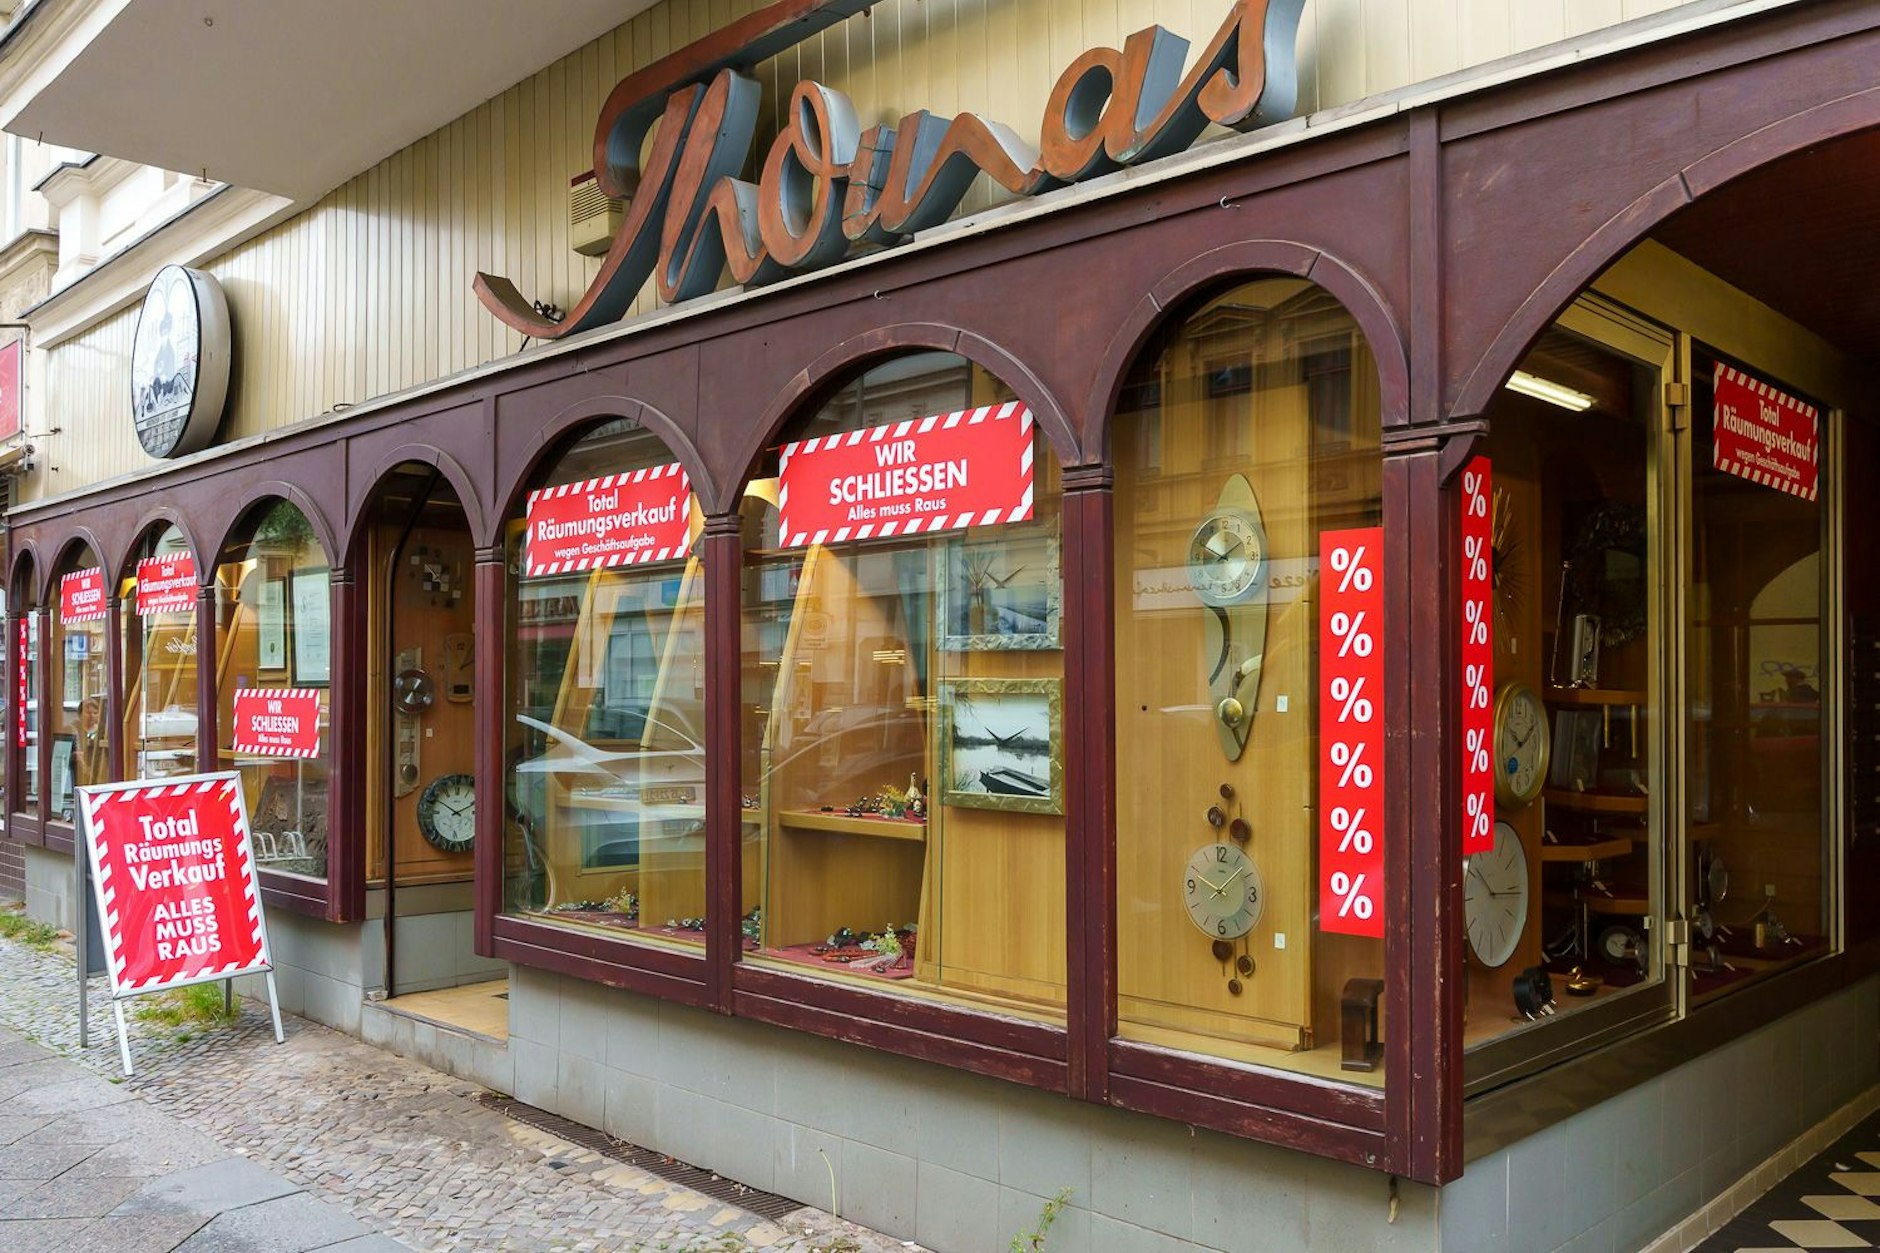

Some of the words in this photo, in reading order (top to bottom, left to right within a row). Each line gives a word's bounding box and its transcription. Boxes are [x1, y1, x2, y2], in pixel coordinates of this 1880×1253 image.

[1759, 400, 1780, 427] Total
[1722, 404, 1811, 462] Räumungsverkauf
[875, 440, 916, 467] WIR
[1735, 448, 1755, 464] wegen
[829, 459, 968, 505] SCHLIESSEN
[1464, 471, 1486, 517] %
[587, 488, 619, 513] Total
[848, 505, 877, 522] Alles
[879, 503, 912, 517] muss
[915, 497, 947, 512] Raus
[538, 496, 676, 541] Räumungsverkauf
[554, 546, 581, 559] wegen
[581, 533, 656, 555] Geschäftsaufgabe
[1464, 534, 1487, 581] %
[1330, 546, 1374, 593] %
[1330, 611, 1374, 658] %
[1465, 599, 1488, 645] %
[1330, 677, 1374, 723] %
[1465, 664, 1488, 709] %
[267, 700, 283, 714] WIR
[251, 715, 299, 734] SCHLIESSEN
[1330, 742, 1374, 788] %
[1466, 728, 1489, 774] %
[138, 809, 199, 841] Total
[1466, 792, 1489, 838] %
[1330, 807, 1374, 854] %
[123, 838, 222, 864] Räumungs
[1216, 846, 1228, 863] 12
[128, 853, 226, 892] Verkauf
[1187, 879, 1196, 894] 9
[154, 896, 216, 922] ALLES
[1248, 886, 1257, 903] 3
[1330, 871, 1374, 920] %
[155, 915, 219, 941] MUSS
[1217, 919, 1226, 935] 6
[157, 934, 222, 961] RAUS
